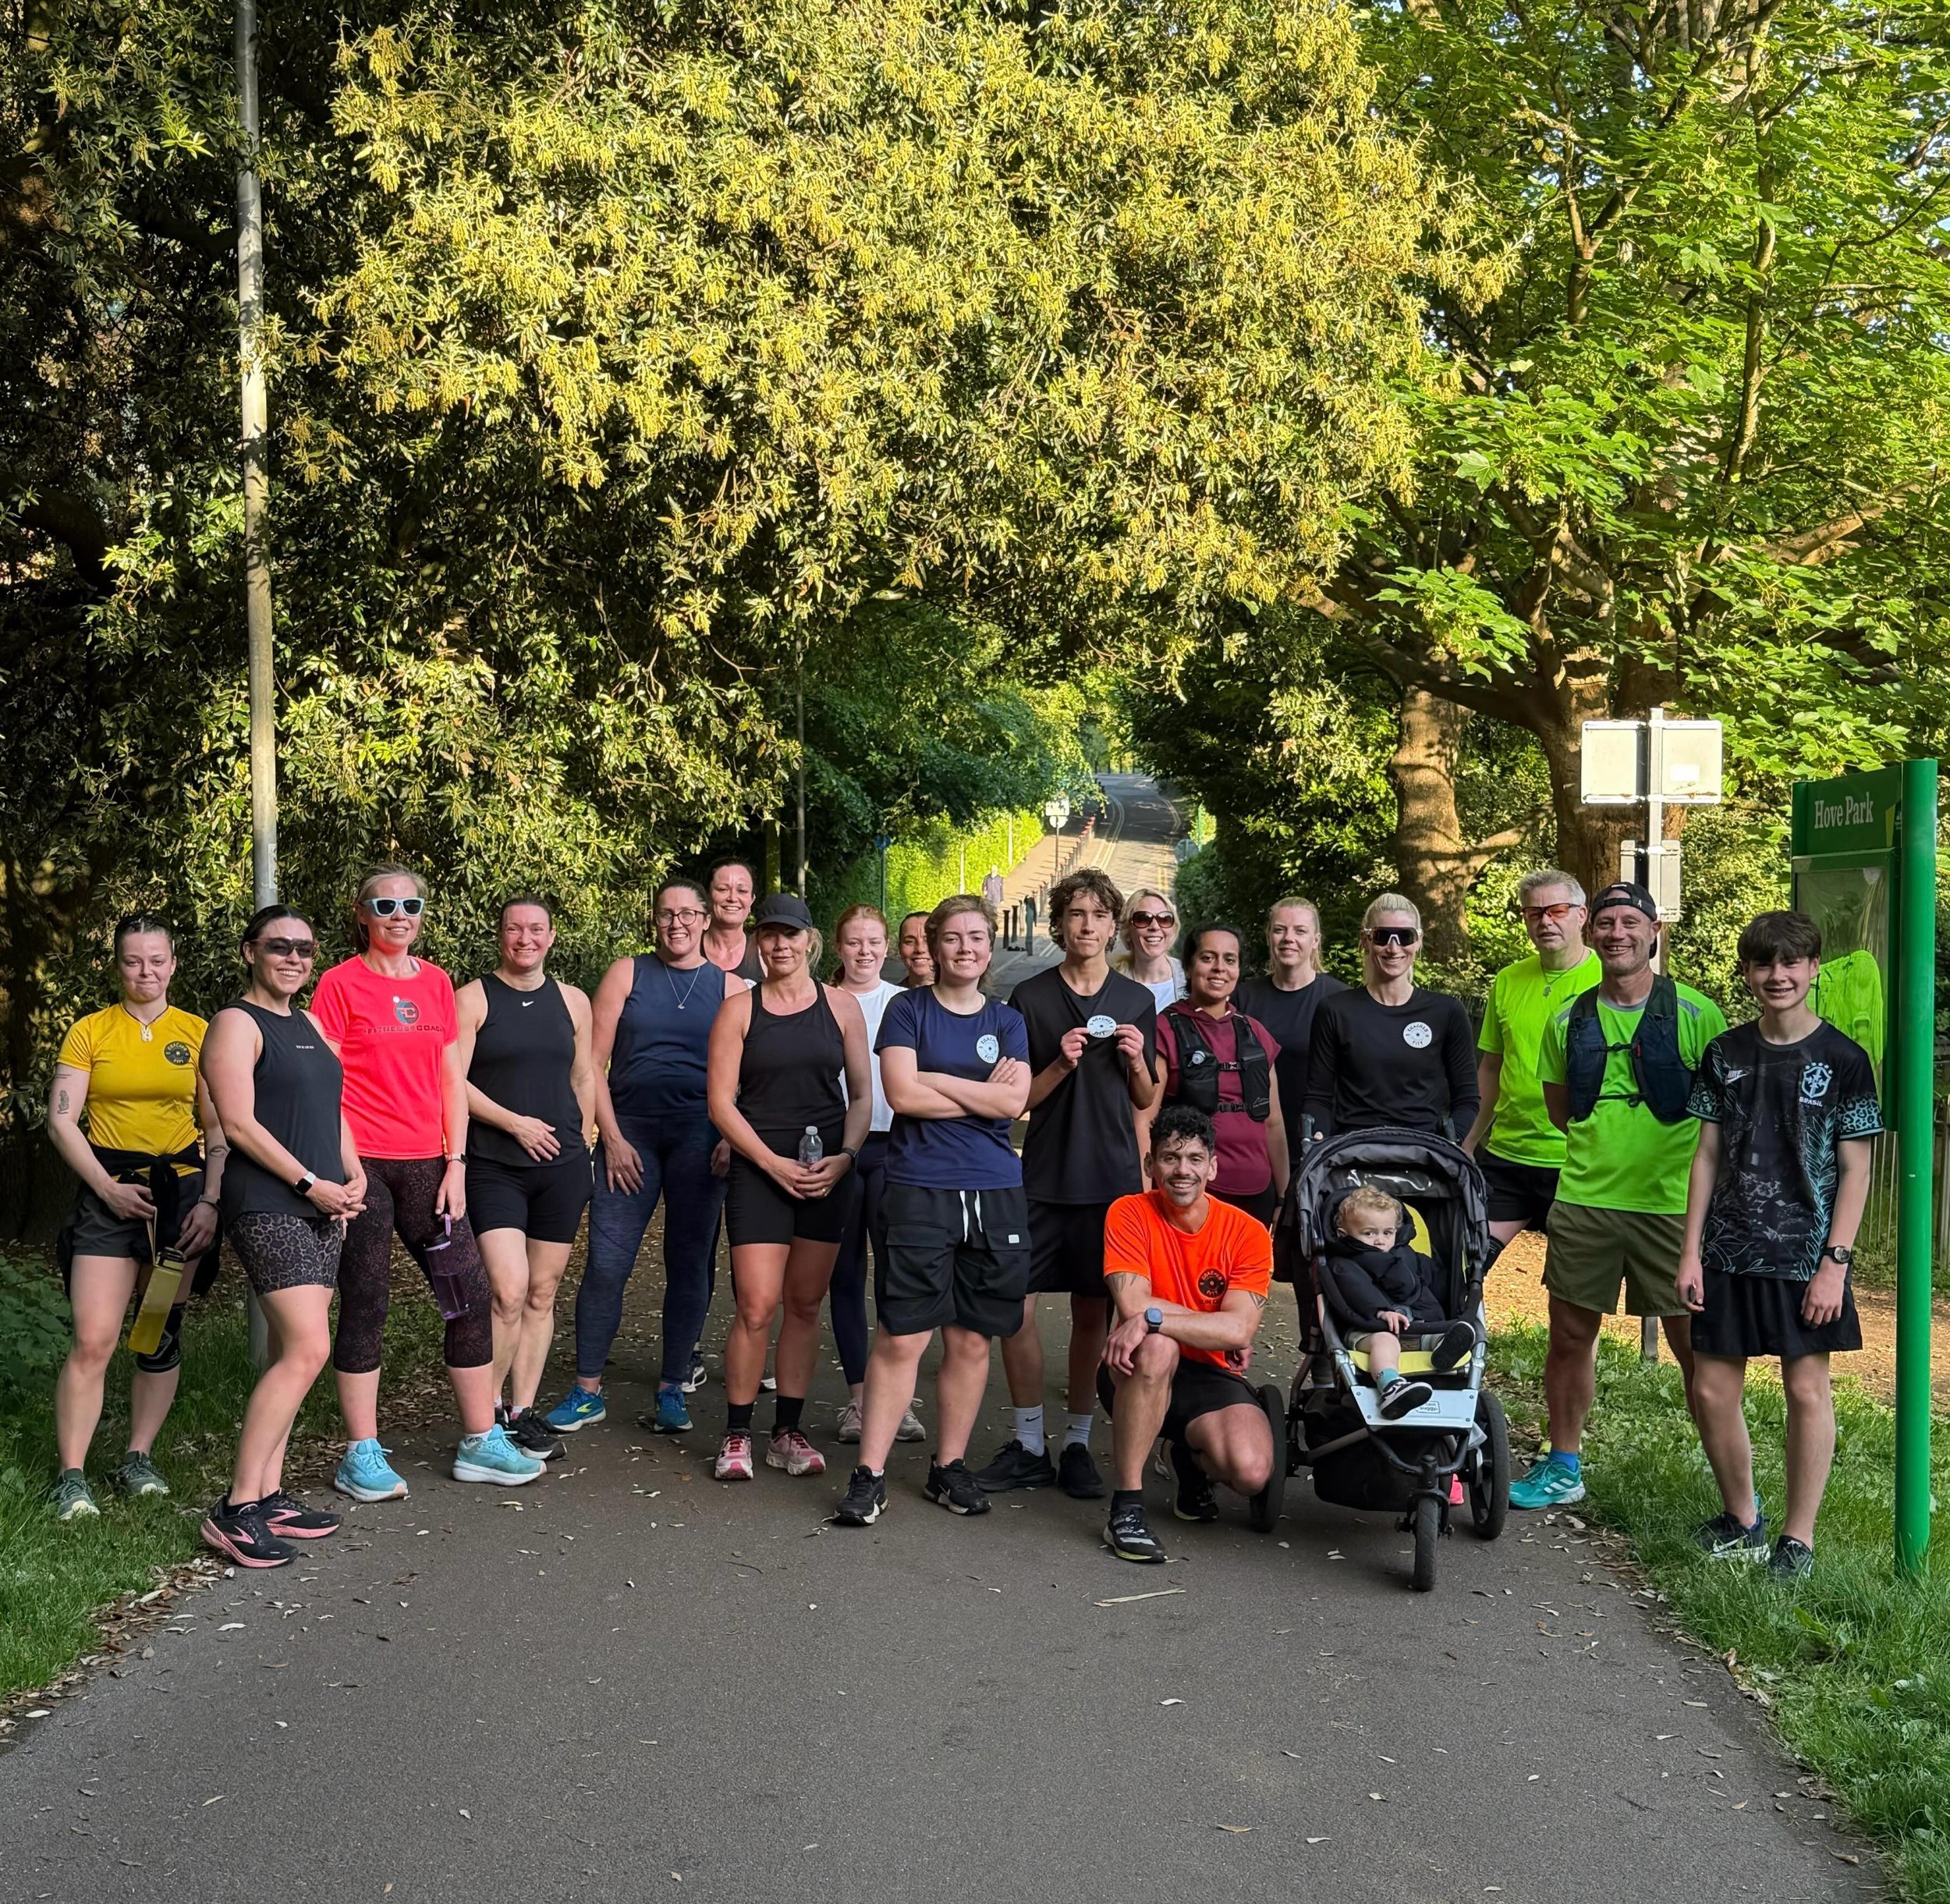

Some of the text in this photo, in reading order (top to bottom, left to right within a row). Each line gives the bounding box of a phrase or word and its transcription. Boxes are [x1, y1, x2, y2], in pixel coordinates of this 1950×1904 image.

[1814, 791, 1874, 829] Hove Park
[1407, 1023, 1429, 1033] COACHED
[167, 1042, 188, 1051] COACHED
[1201, 1271, 1223, 1281] COACHED
